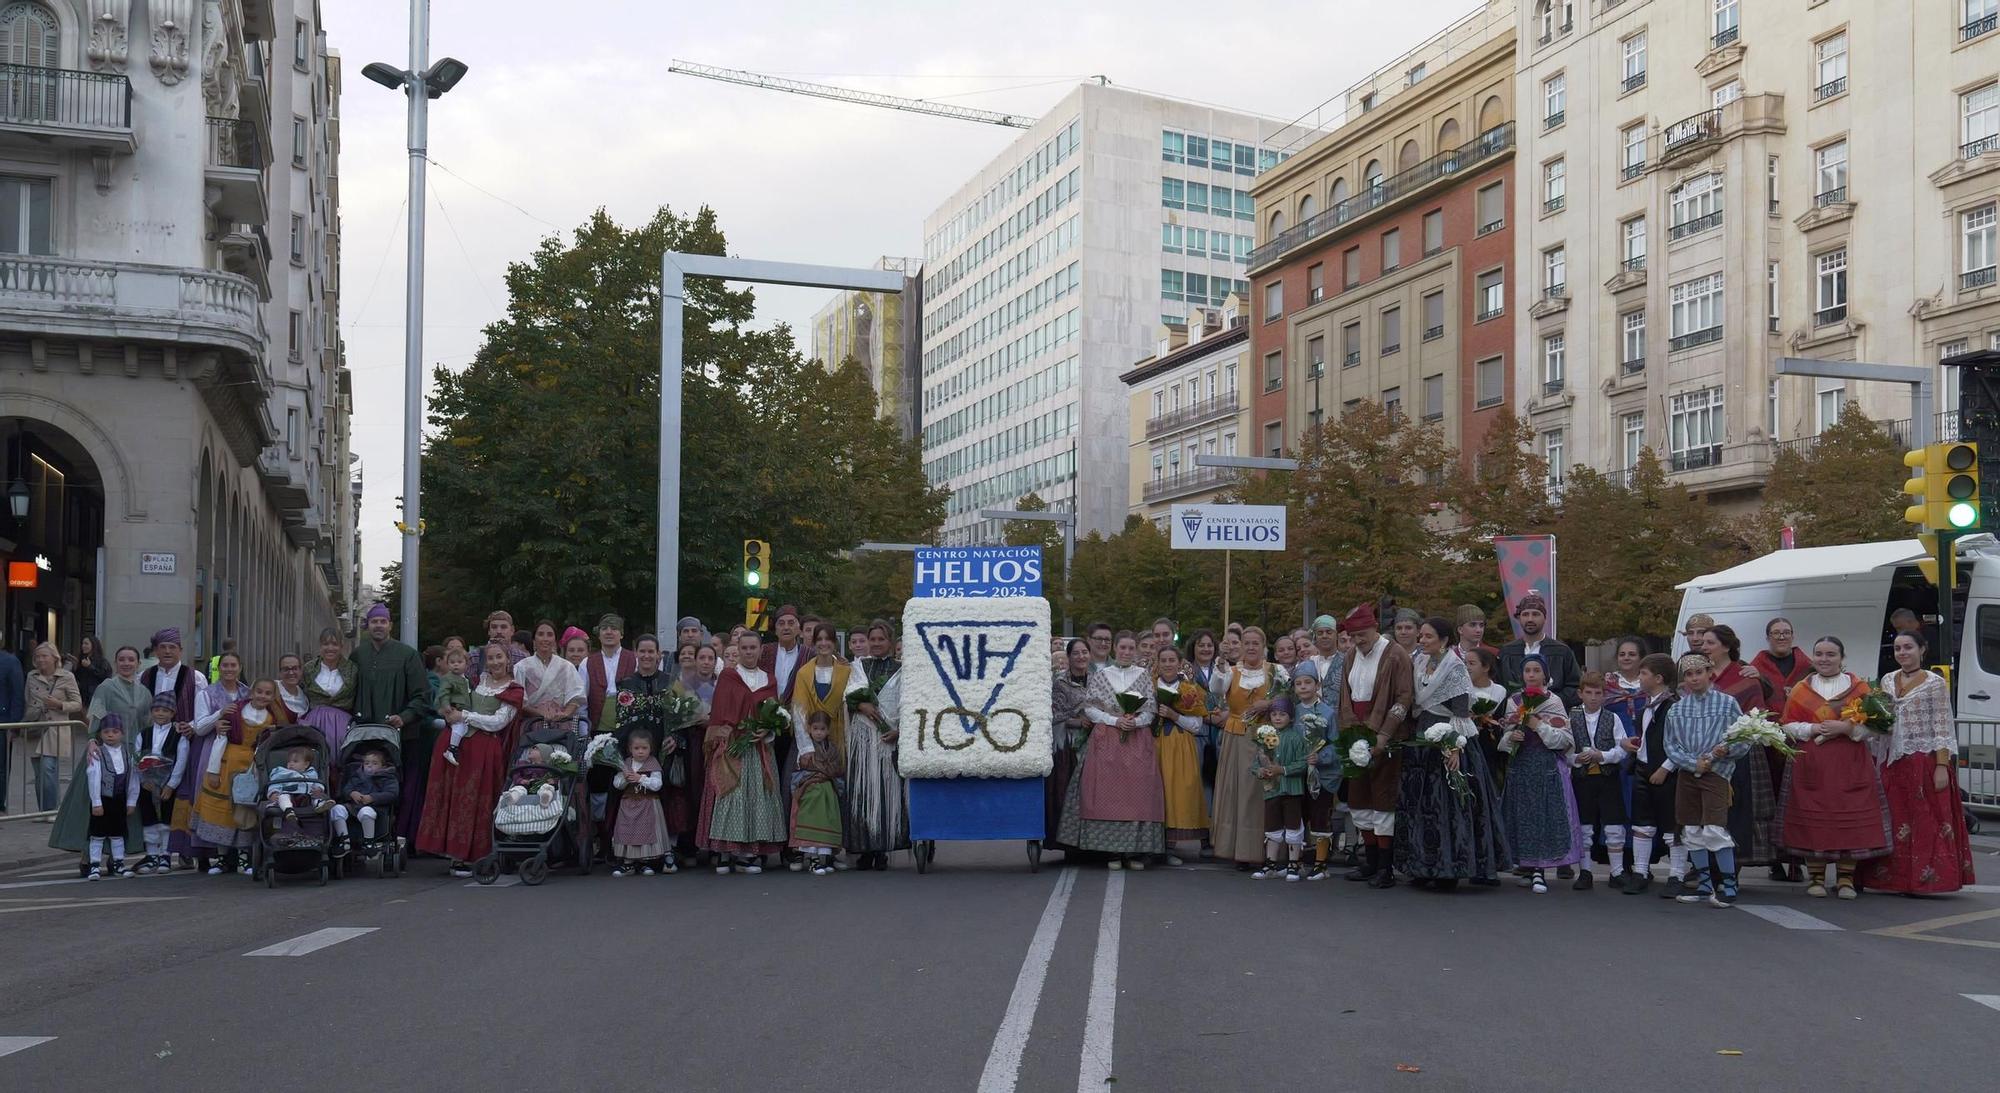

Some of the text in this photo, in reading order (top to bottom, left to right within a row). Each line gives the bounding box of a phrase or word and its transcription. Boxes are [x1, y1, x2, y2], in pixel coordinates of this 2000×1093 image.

[1207, 526, 1280, 542] HELIOS
[917, 547, 1040, 559] CENTRO NATACIÓN
[916, 559, 1040, 584] HELIOS
[930, 587, 964, 598] 1925
[991, 586, 1027, 597] 2025
[913, 706, 1031, 752] 100
